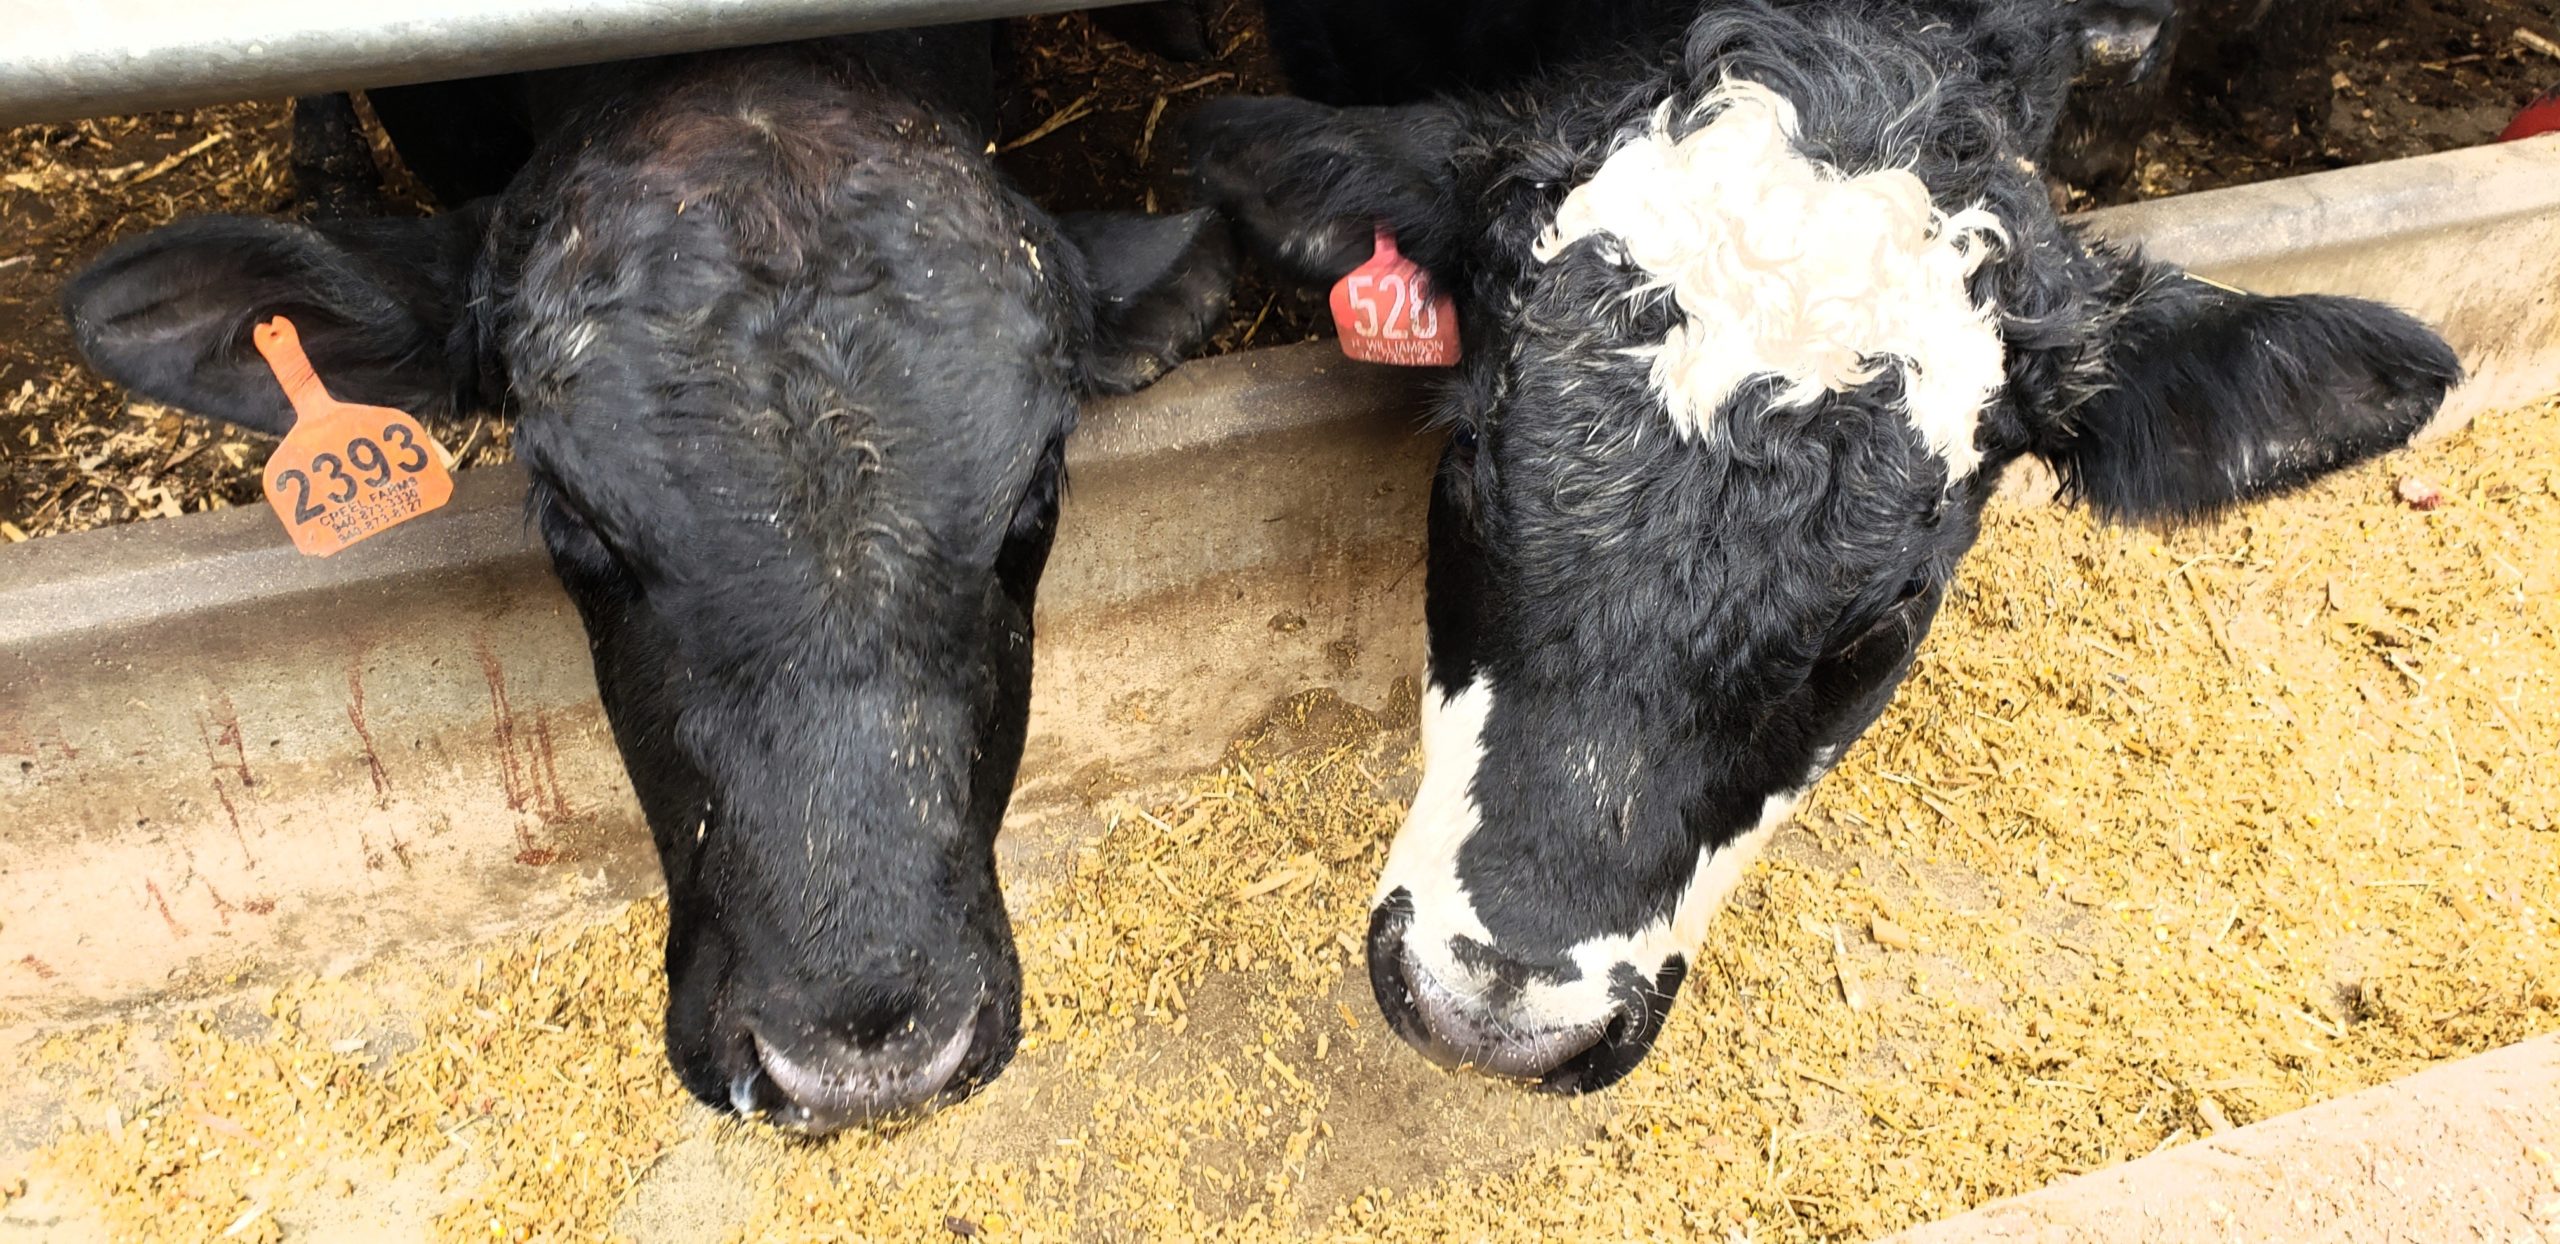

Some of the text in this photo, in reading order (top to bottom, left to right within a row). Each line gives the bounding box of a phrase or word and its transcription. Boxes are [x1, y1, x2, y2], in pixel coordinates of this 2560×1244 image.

[1347, 271, 1438, 339] 528
[1366, 339, 1444, 354] WILLIAMSON
[276, 423, 429, 526] 2393
[368, 476, 418, 502] FARMS
